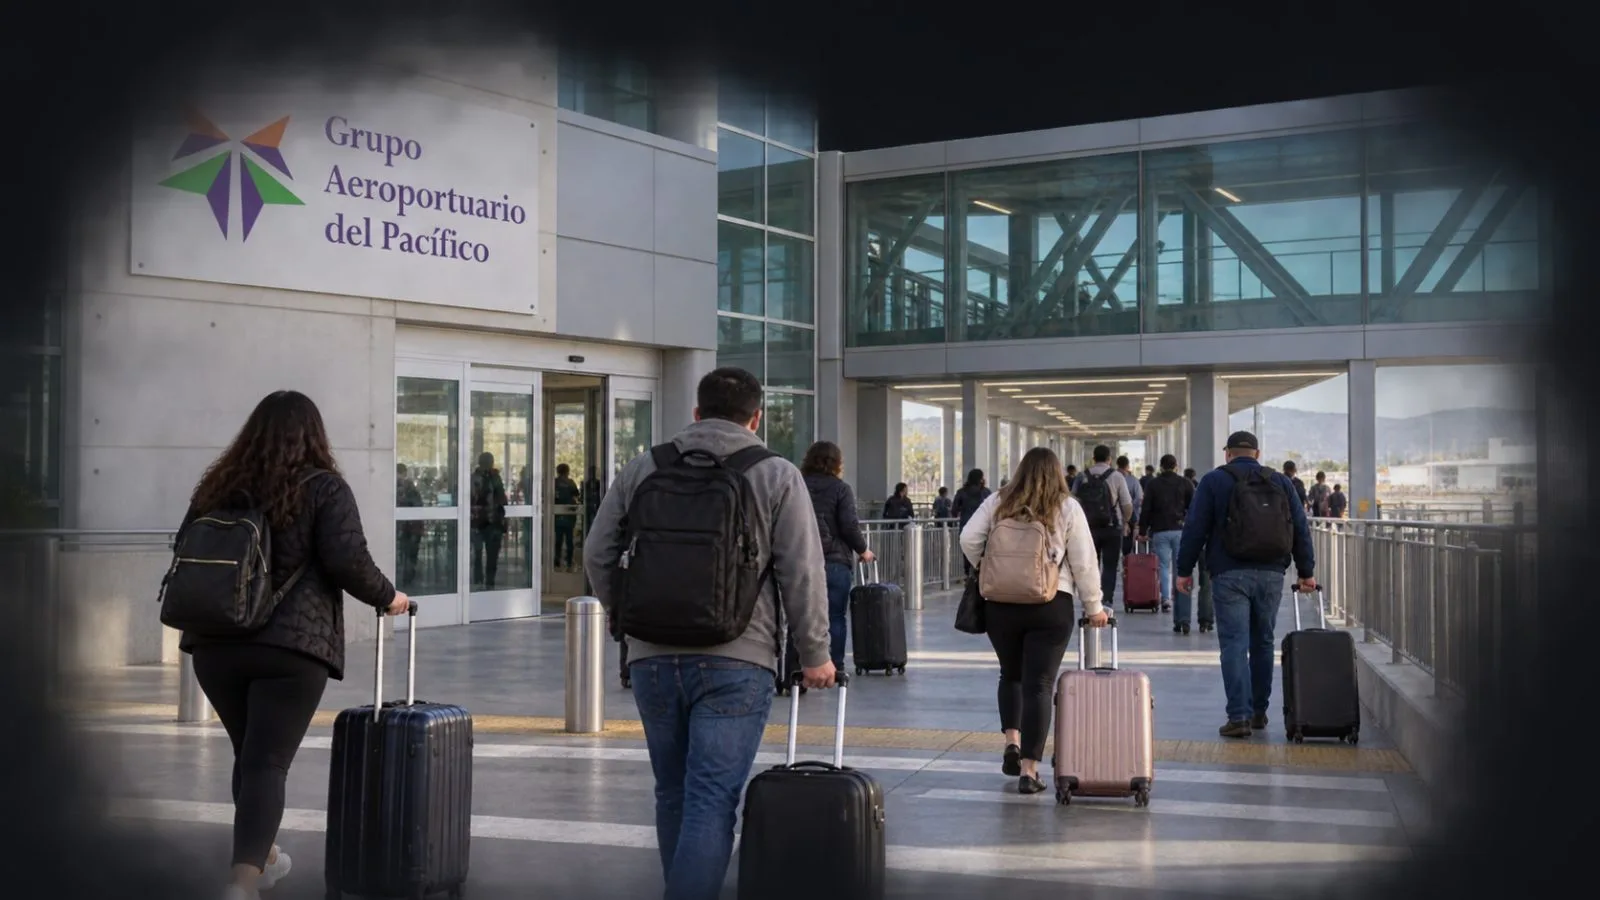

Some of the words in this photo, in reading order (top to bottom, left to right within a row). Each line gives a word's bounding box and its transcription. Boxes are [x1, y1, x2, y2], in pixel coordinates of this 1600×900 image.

[323, 115, 423, 168] Grupo
[323, 164, 527, 225] Aeroportuario
[324, 212, 373, 248] del
[381, 220, 490, 263] Pacífico
